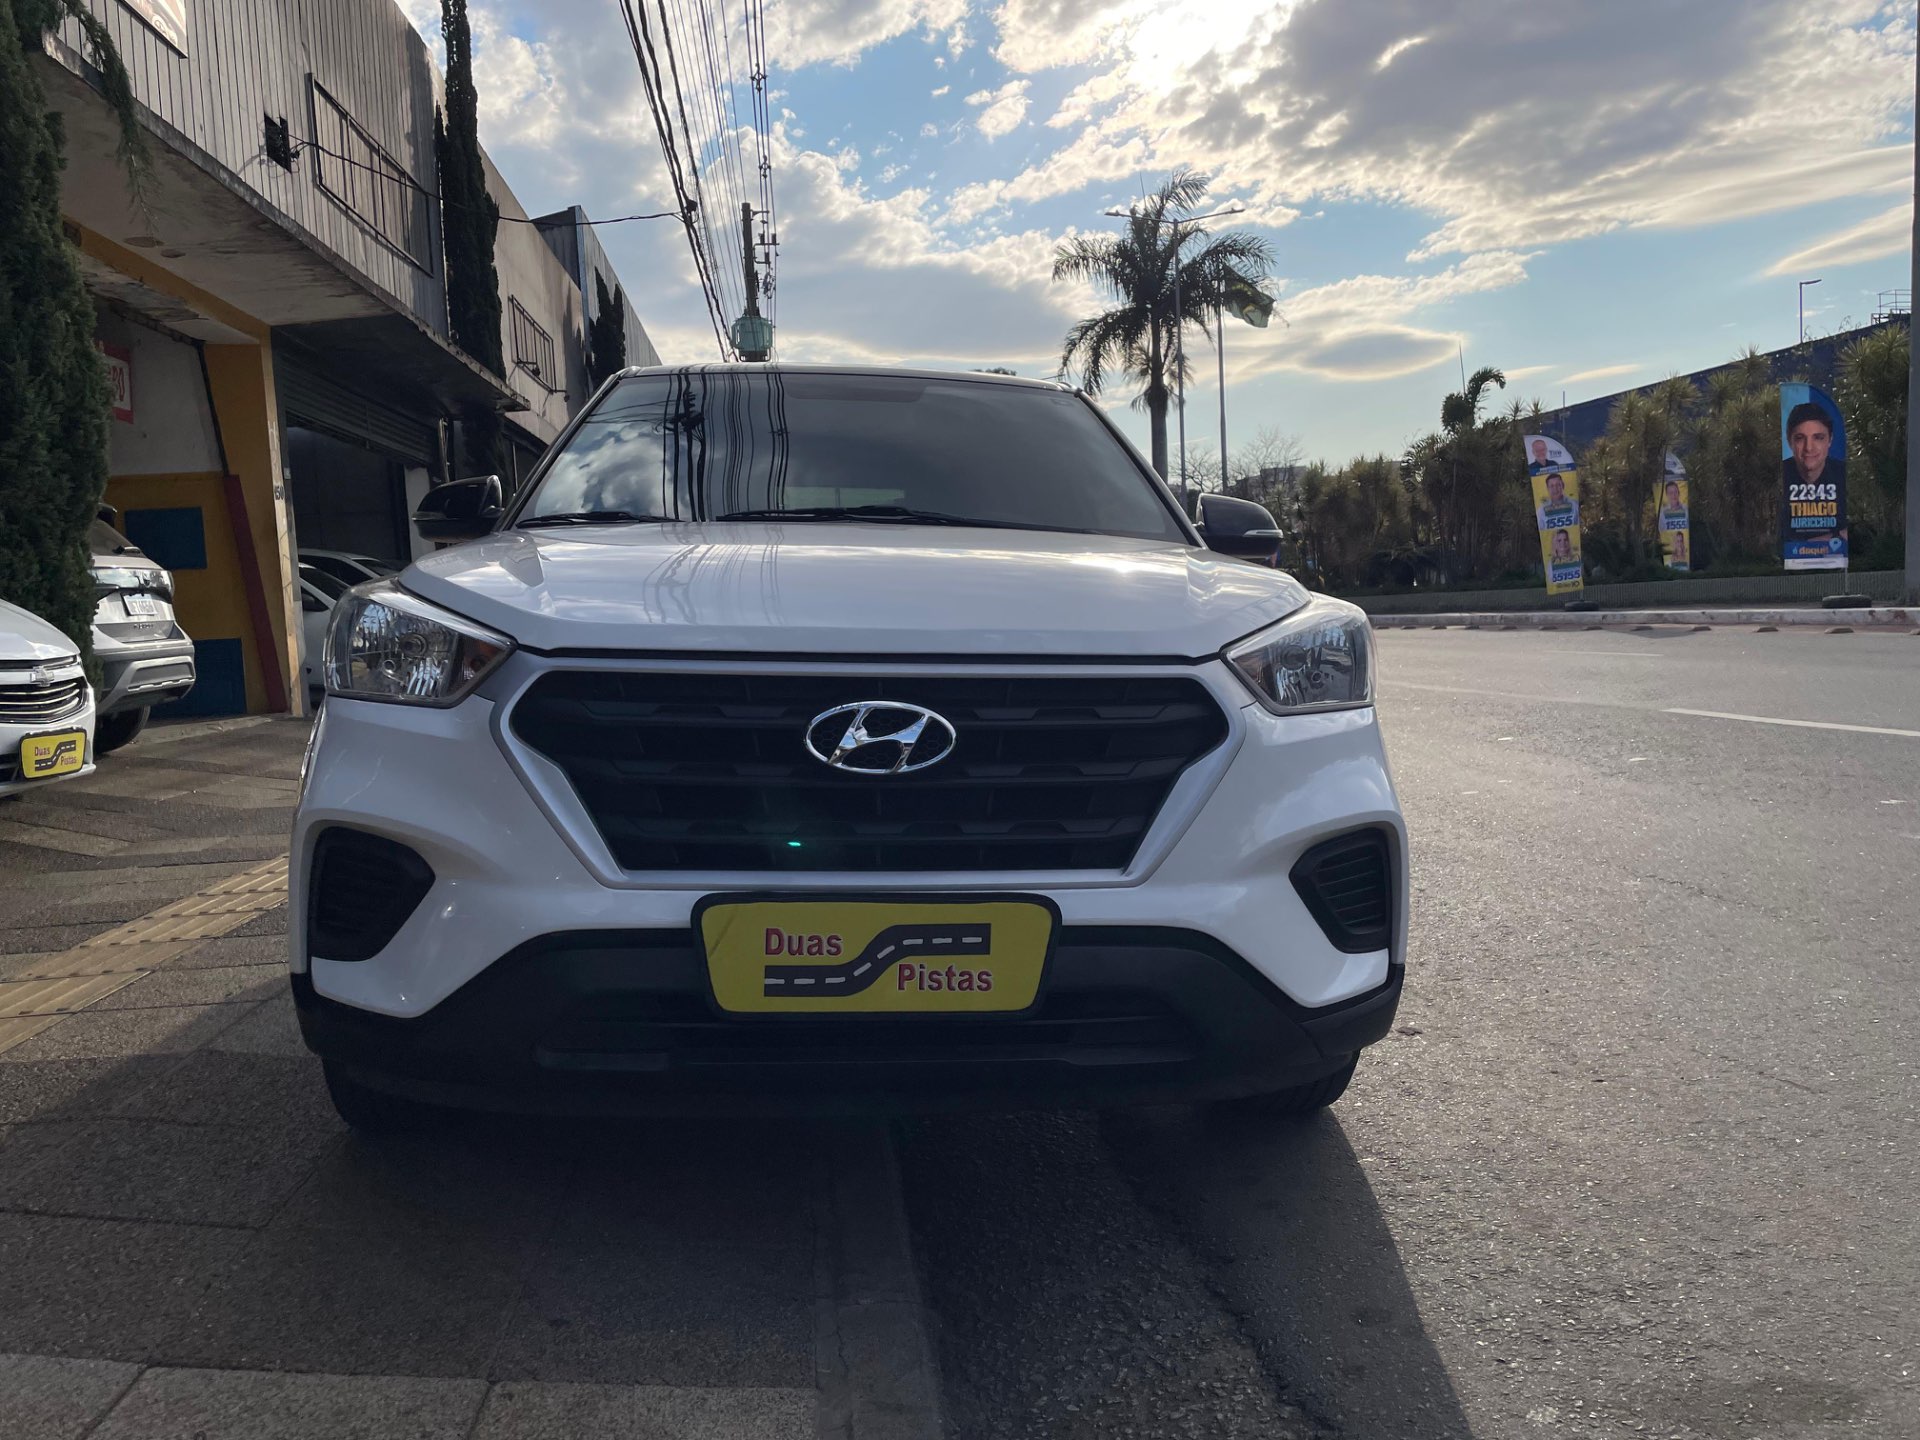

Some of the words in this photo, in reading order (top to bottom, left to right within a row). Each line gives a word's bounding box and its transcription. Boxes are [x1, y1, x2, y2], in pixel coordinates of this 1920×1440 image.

[1789, 484, 1837, 500] 22343
[1790, 502, 1837, 516] THIAGO
[1546, 515, 1573, 529] 1555
[34, 746, 50, 757] Duas
[60, 755, 77, 766] Pistas
[764, 927, 843, 956] Duas
[897, 963, 993, 992] Pistas
